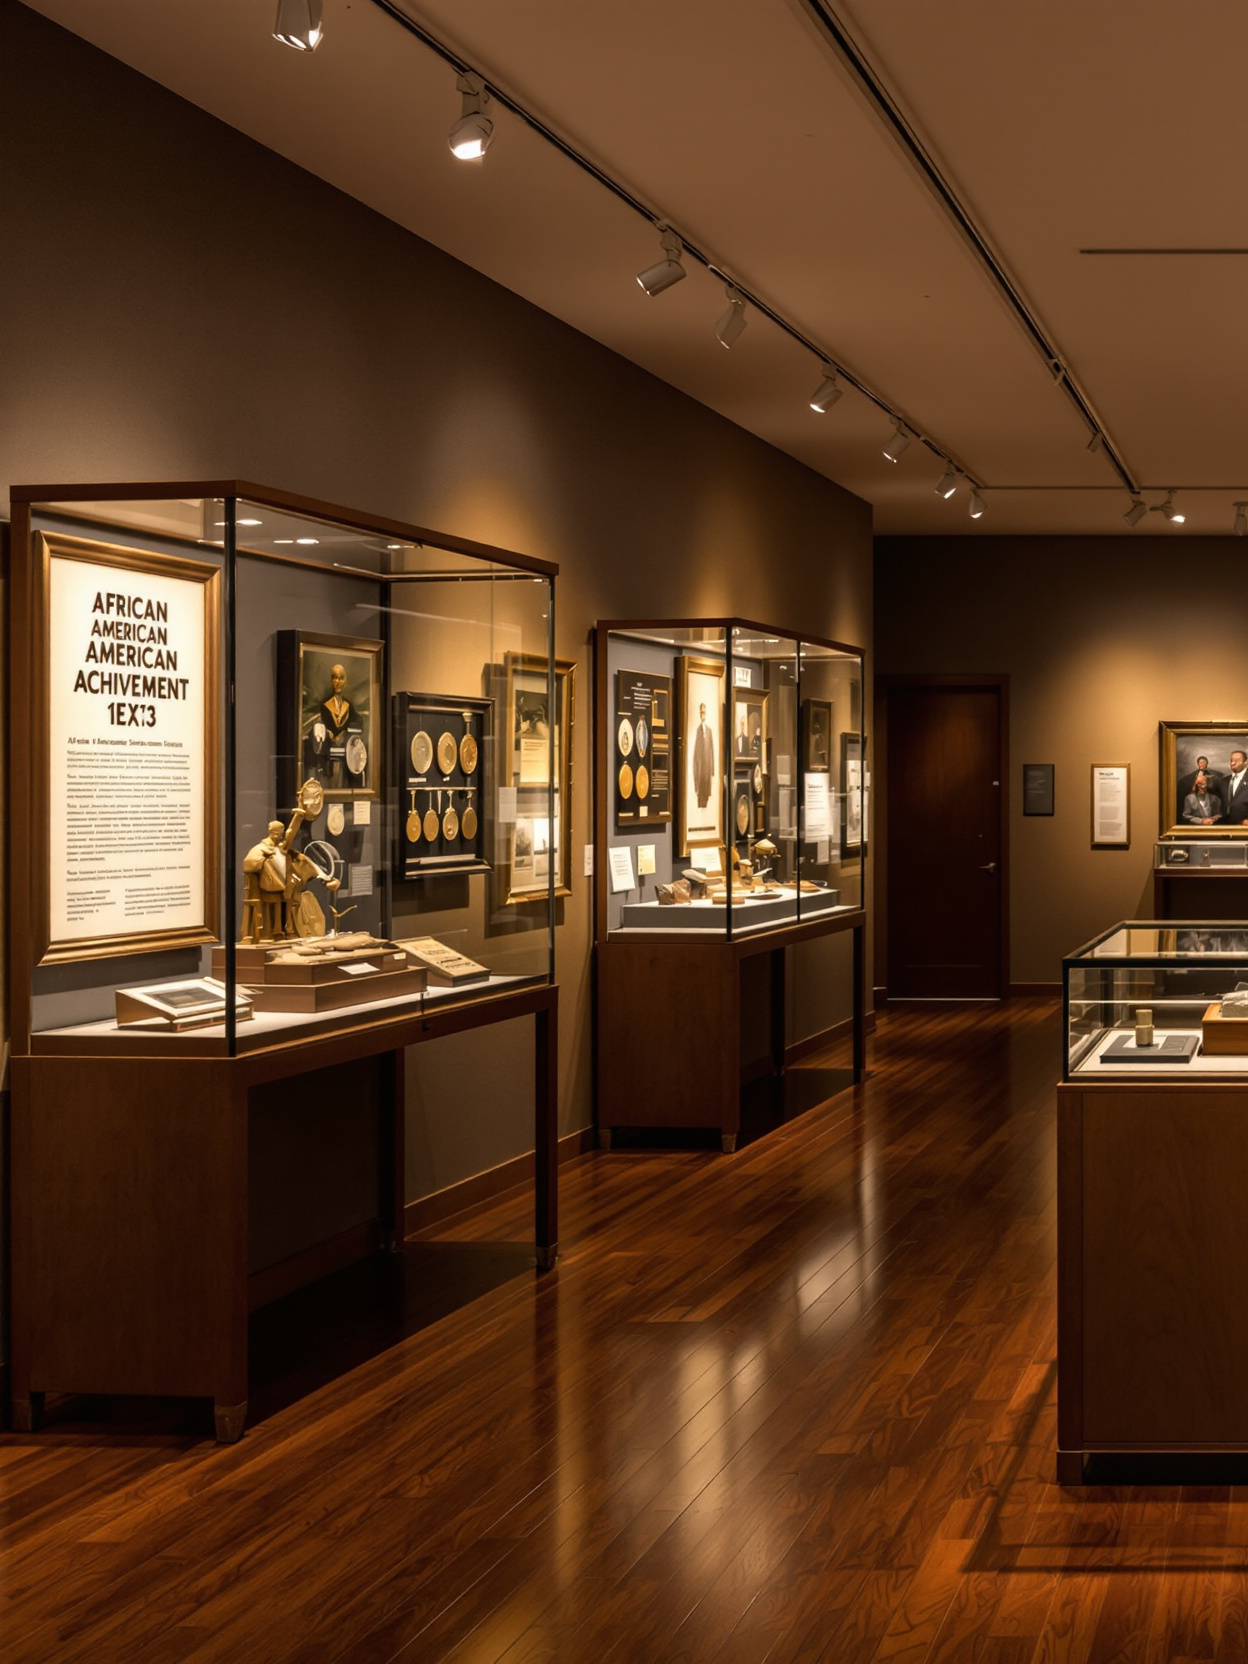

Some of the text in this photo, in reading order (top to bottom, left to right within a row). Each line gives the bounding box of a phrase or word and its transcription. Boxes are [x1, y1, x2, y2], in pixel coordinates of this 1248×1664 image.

[92, 592, 168, 623] AFRICAN
[91, 619, 168, 646] AMERICAN
[85, 640, 178, 671] AMERICAN
[73, 669, 190, 700] ACHIVEMENT
